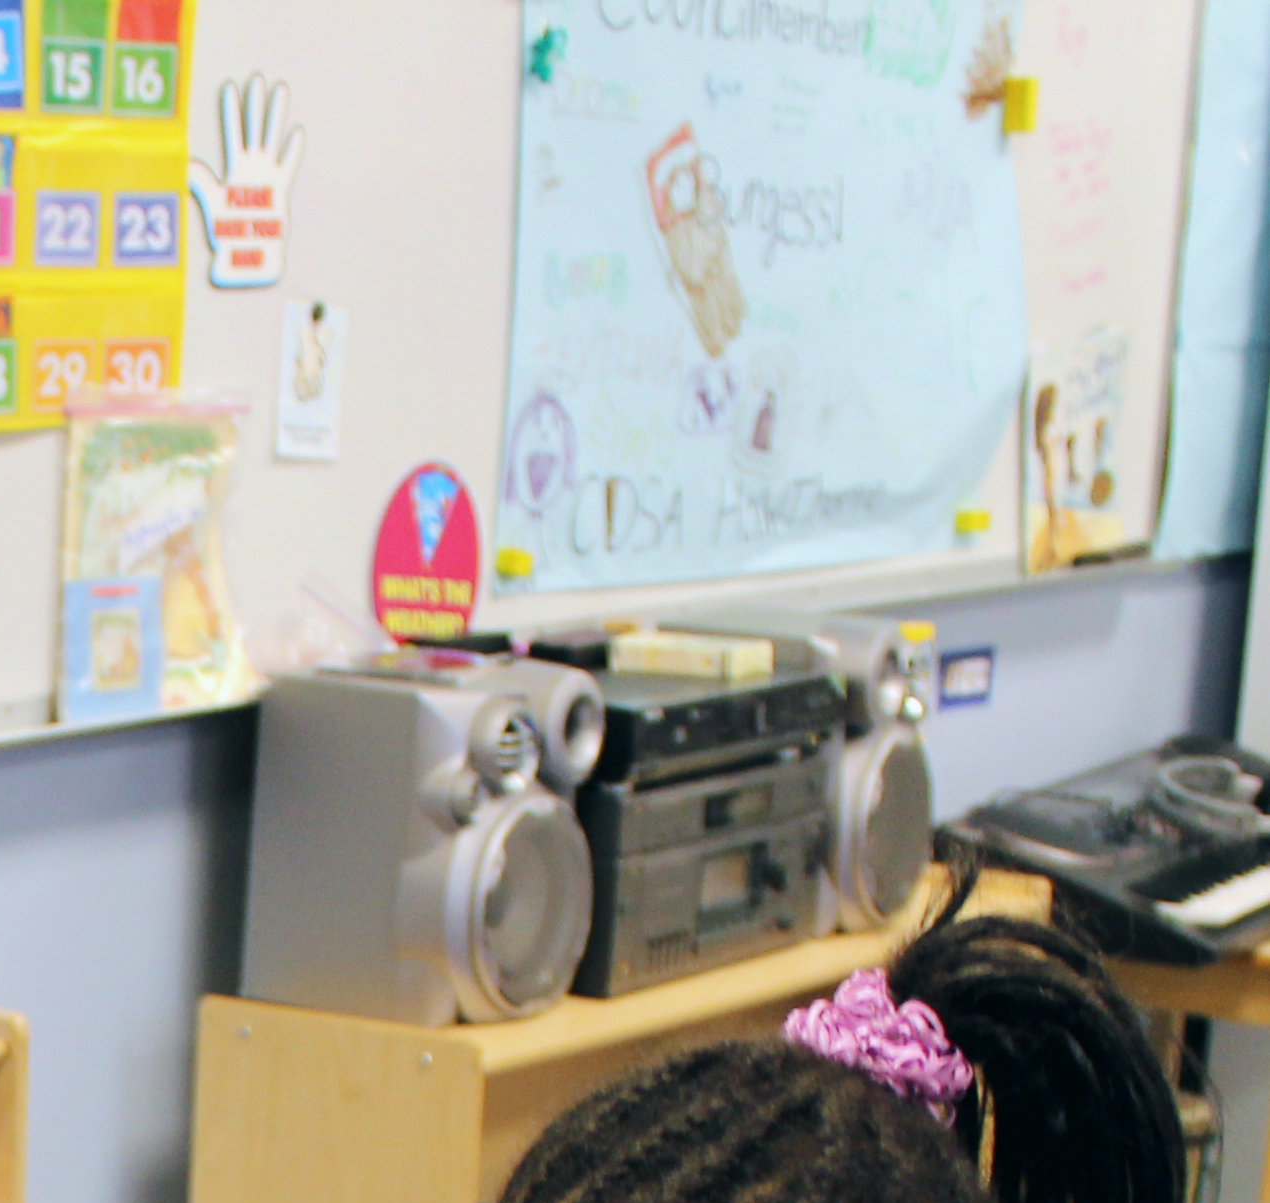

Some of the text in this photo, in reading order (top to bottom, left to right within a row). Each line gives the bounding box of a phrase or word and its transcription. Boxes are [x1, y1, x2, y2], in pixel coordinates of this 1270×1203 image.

[49, 51, 92, 101] 15
[120, 55, 165, 105] 16
[42, 202, 93, 252] 22
[120, 203, 173, 252] 23
[38, 351, 88, 398] 29
[109, 350, 162, 396] 30
